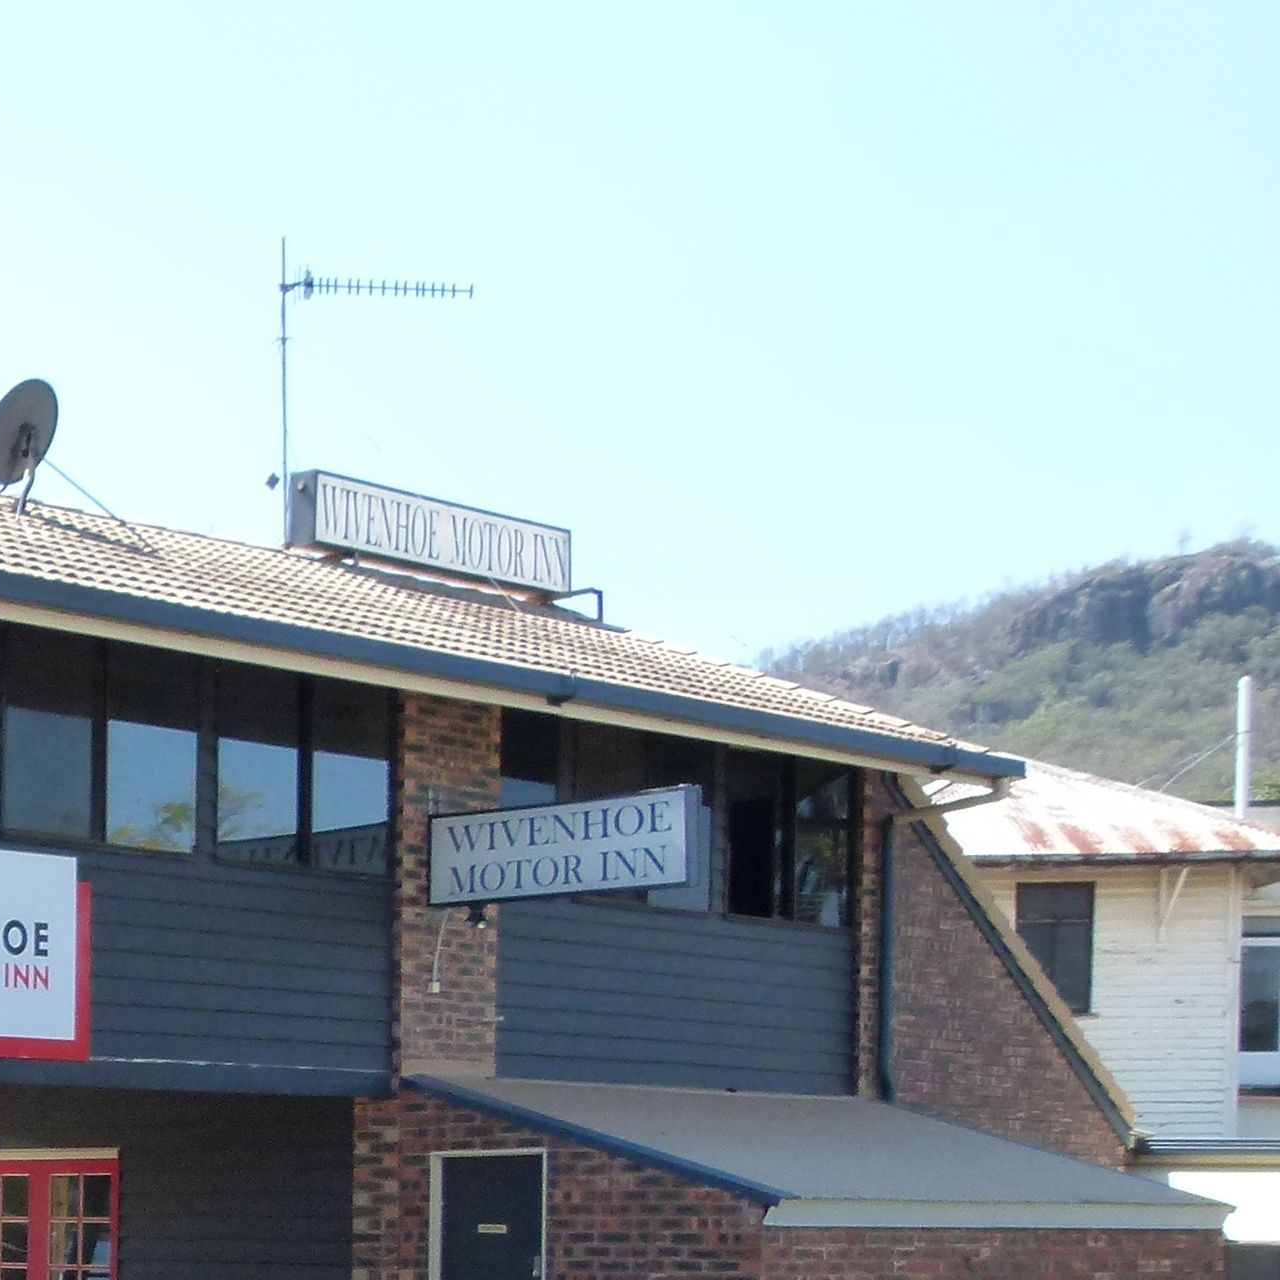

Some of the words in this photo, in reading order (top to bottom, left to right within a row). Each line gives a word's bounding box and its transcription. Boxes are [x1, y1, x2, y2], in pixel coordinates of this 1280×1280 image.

[321, 483, 440, 560] WIVENHOE
[449, 514, 525, 579] MOTOR
[533, 533, 568, 586] INN
[446, 800, 673, 854] WIVENHOE
[448, 854, 583, 896] MOTOR
[599, 844, 667, 882] INN
[4, 962, 49, 991] INN
